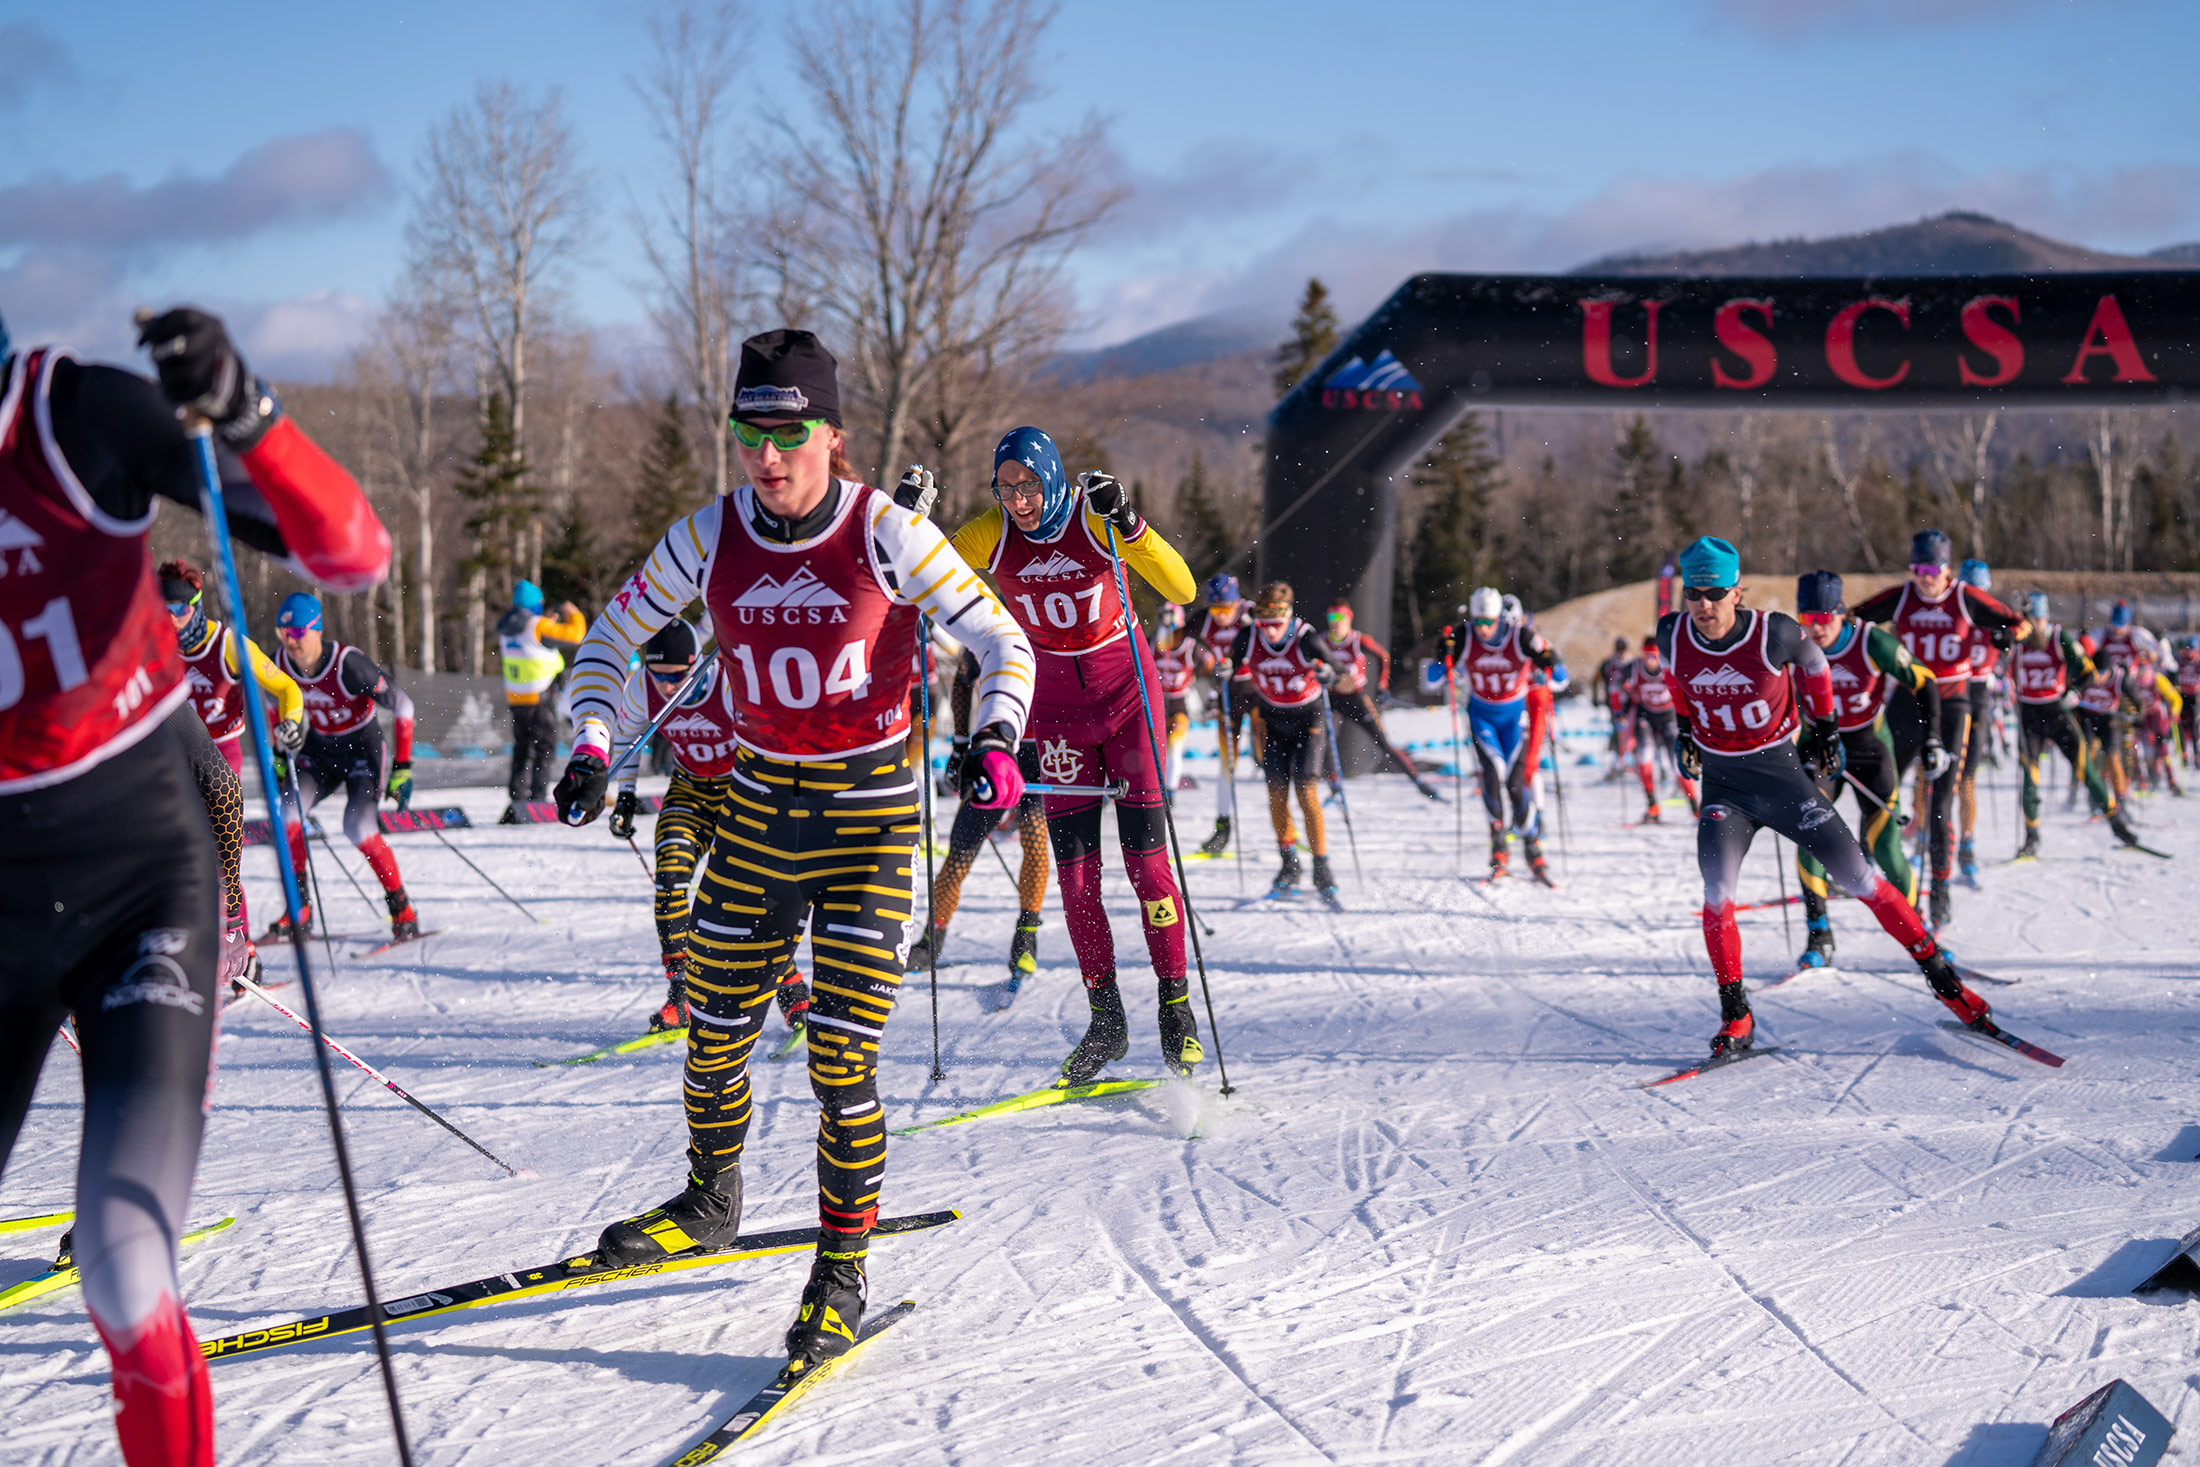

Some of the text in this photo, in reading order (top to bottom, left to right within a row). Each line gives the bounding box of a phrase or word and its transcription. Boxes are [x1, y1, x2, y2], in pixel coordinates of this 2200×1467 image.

[1577, 294, 2158, 390] USCSA
[1321, 388, 1424, 411] USCSA
[1020, 570, 1087, 584] USCSA
[738, 606, 848, 625] USCSA
[1015, 582, 1104, 629] 107
[1901, 631, 1962, 662] 116
[732, 639, 872, 710] 104
[1472, 670, 1518, 693] 117
[112, 665, 154, 721] 101
[1692, 684, 1754, 695] USCSA
[1689, 699, 1772, 732] 110
[666, 729, 723, 738] USCSA
[821, 1247, 869, 1260] FISCHE
[563, 1264, 663, 1290] FISCHER
[198, 1316, 329, 1357] FISCHE
[2093, 1413, 2147, 1467] USCSA
